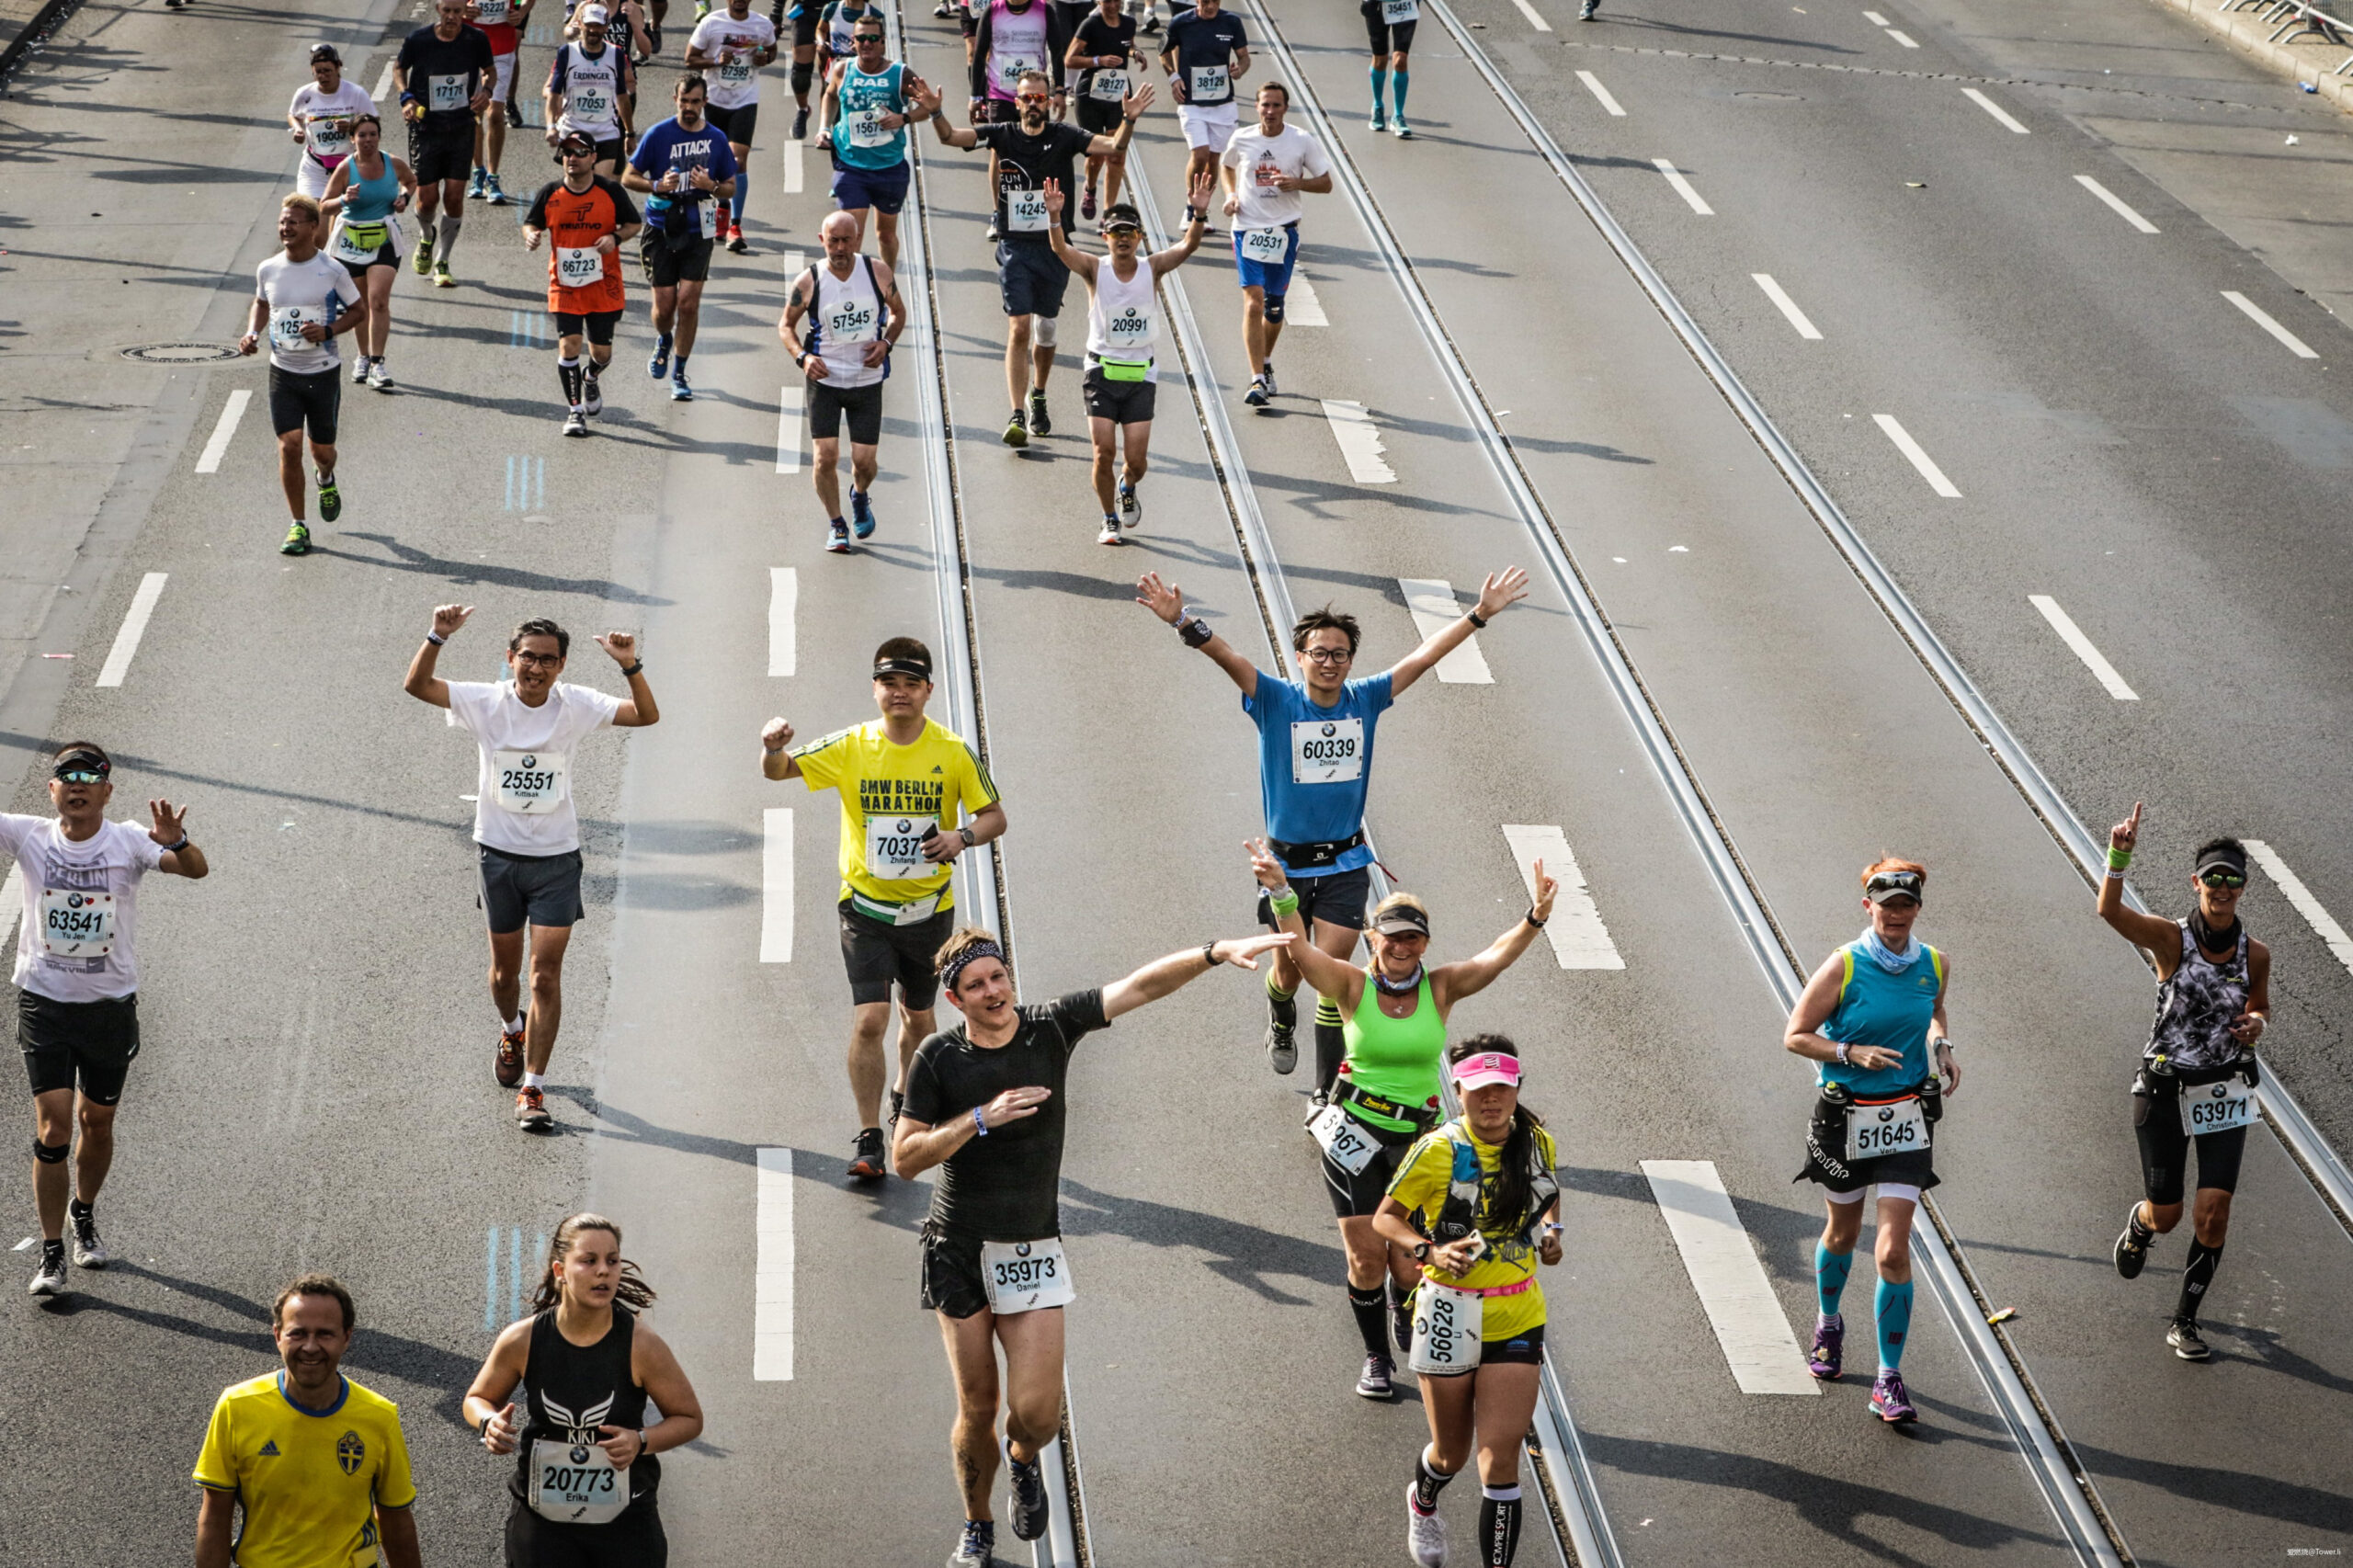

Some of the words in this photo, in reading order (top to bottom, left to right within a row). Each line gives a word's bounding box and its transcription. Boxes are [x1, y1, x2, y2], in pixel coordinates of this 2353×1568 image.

[1388, 2, 1412, 14] 35451
[573, 71, 610, 81] ERDINGER
[722, 65, 749, 76] 67595
[853, 78, 890, 86] RAB
[1097, 79, 1125, 89] 38127
[1197, 76, 1225, 87] 38129
[576, 97, 606, 108] 17053
[856, 121, 885, 133] 1567
[669, 139, 712, 159] ATTACK
[1015, 202, 1047, 216] 14245
[1250, 234, 1282, 249] 20531
[563, 259, 596, 272] 66723
[280, 320, 314, 334] 125
[833, 311, 870, 329] 57545
[1112, 318, 1147, 332] 20991
[1303, 738, 1355, 759] 60339
[502, 770, 553, 790] 25551
[860, 779, 892, 794] BMW
[895, 780, 943, 796] BERLIN
[860, 795, 941, 811] MARATHON
[878, 837, 921, 856] 7037
[891, 857, 916, 865] Zhifang
[49, 909, 103, 933] 63541
[62, 931, 72, 939] Yu
[74, 932, 85, 940] Jen
[2193, 1097, 2246, 1124] 63971
[2207, 1120, 2239, 1131] Christina
[1324, 1114, 1367, 1156] 5967
[1859, 1120, 1915, 1149] 51645
[995, 1256, 1056, 1286] 35973
[1017, 1281, 1041, 1292] Daniel
[1429, 1299, 1454, 1363] 56628
[568, 1429, 595, 1444] KIKI
[543, 1466, 614, 1492] 20773
[566, 1493, 589, 1503] Erika
